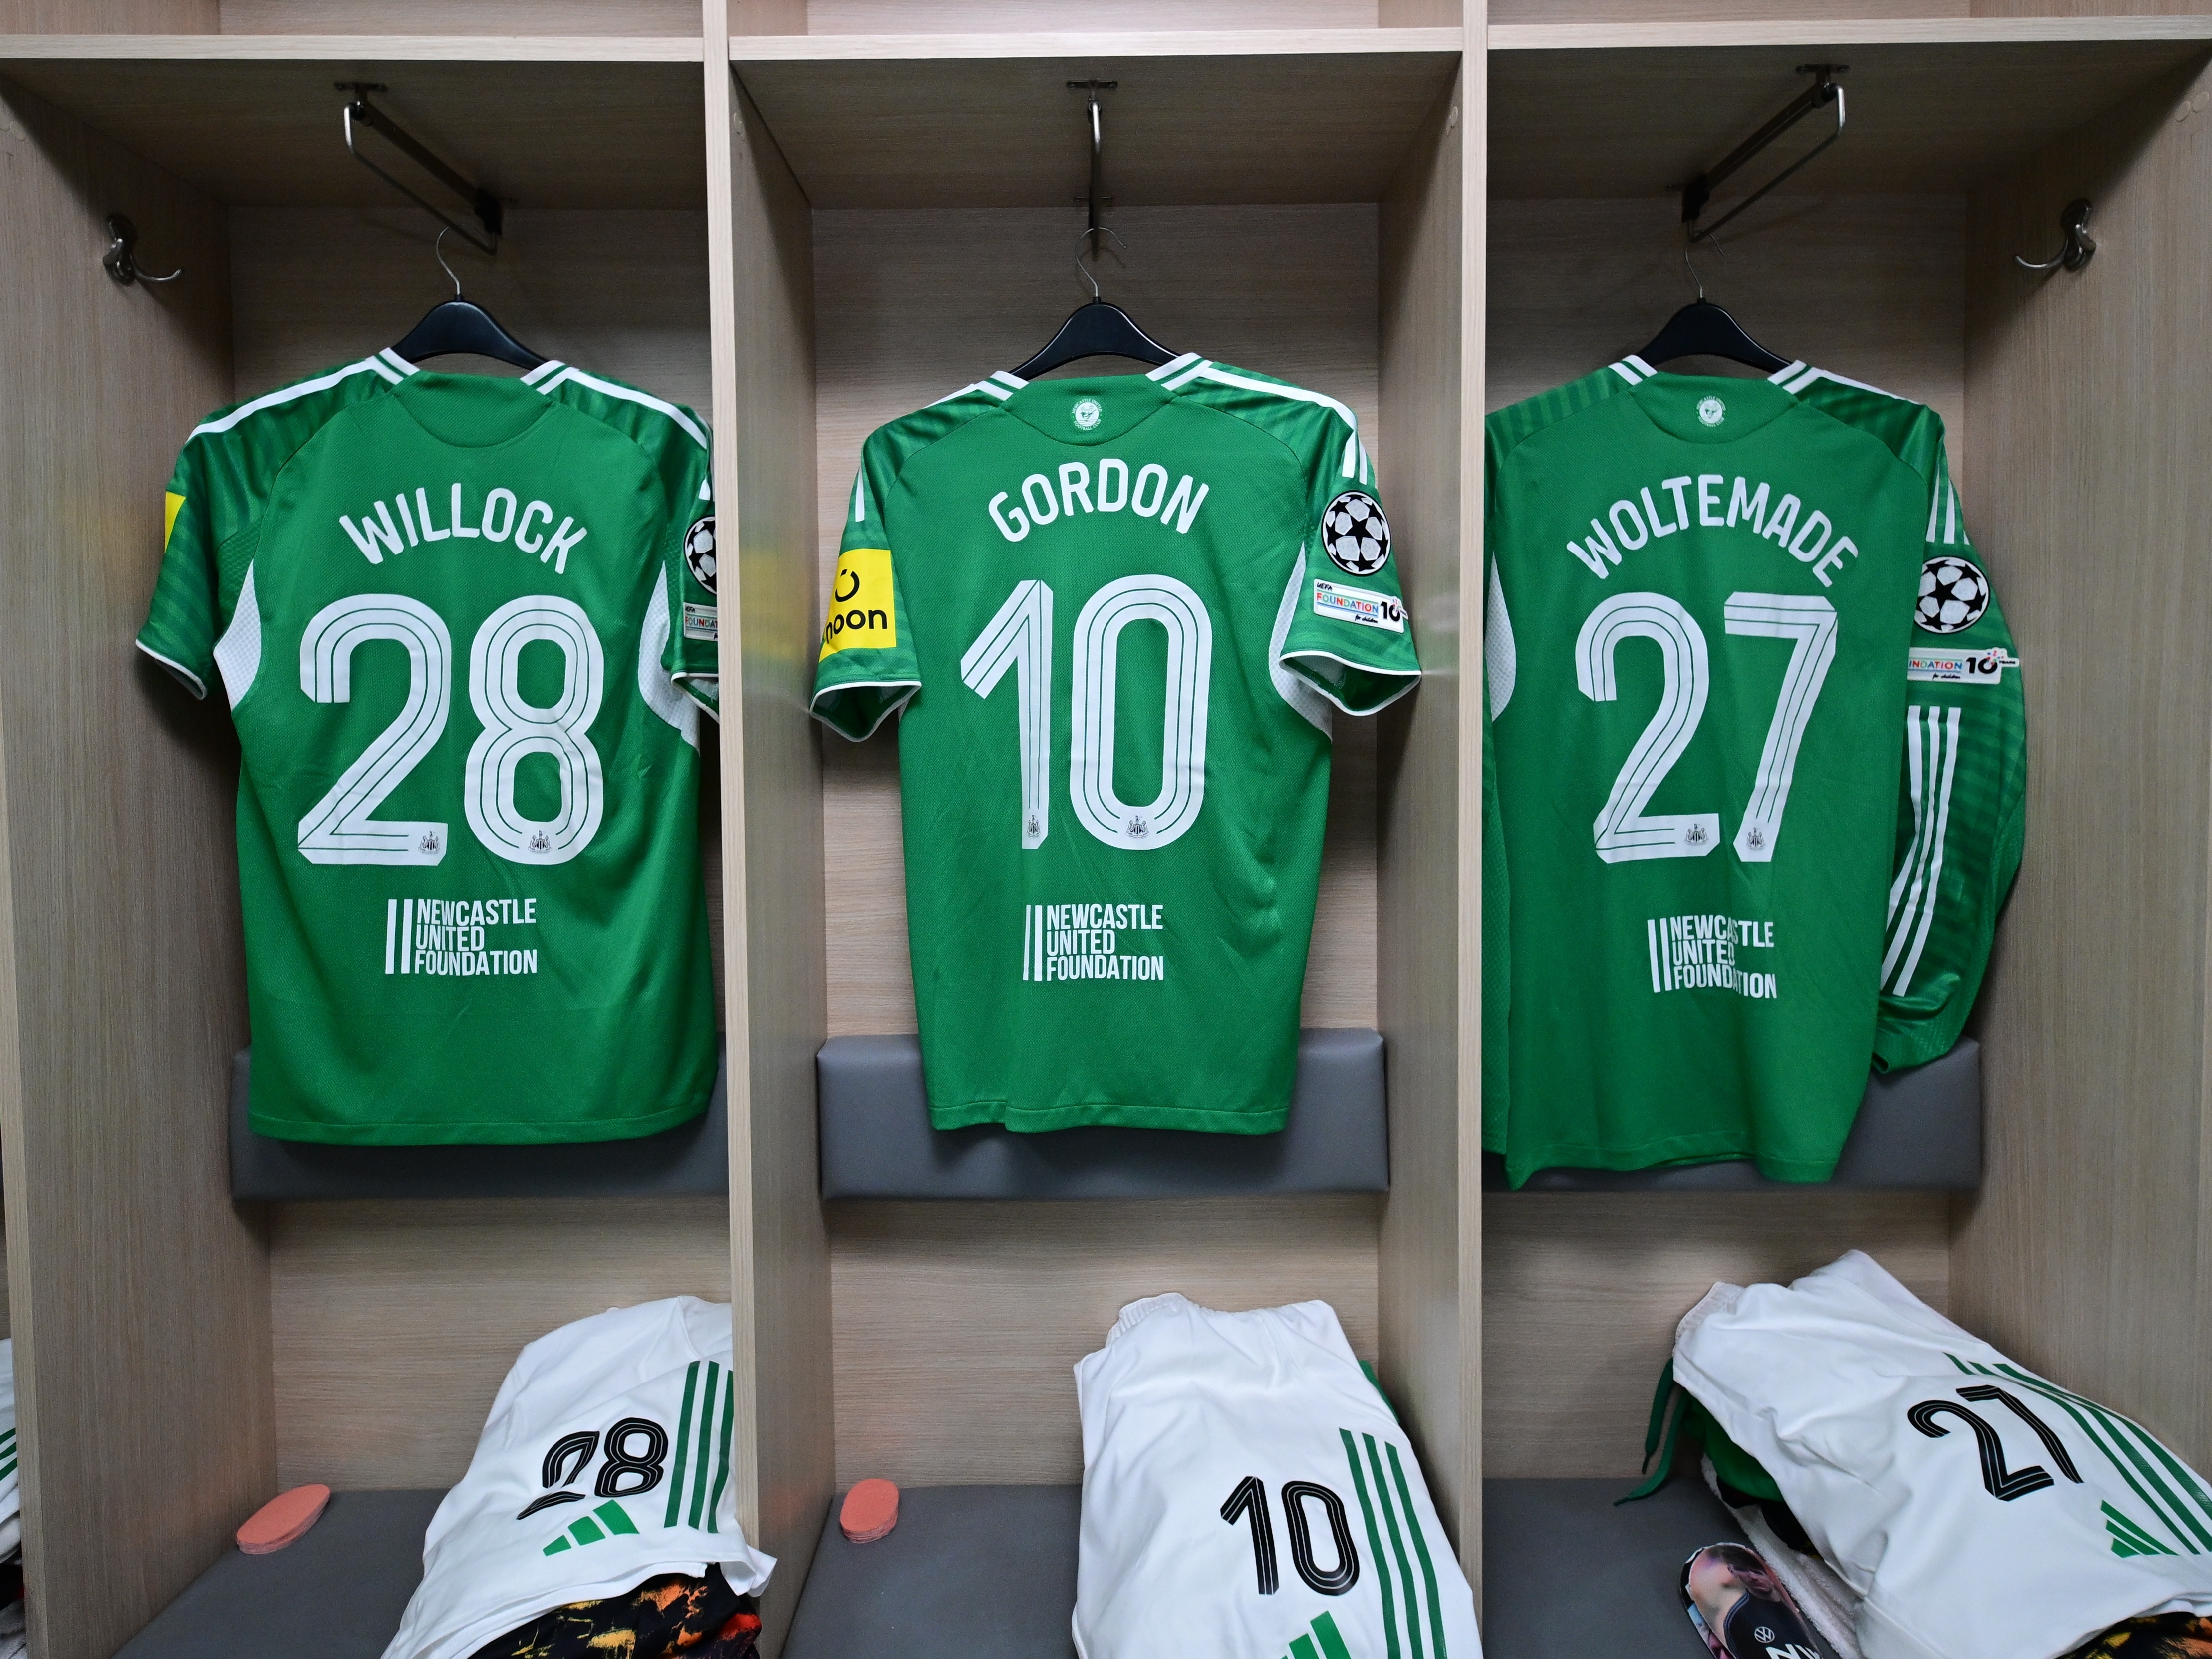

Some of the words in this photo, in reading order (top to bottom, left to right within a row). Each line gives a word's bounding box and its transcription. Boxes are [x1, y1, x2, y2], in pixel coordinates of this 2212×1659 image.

[988, 458, 1209, 542] GORDON
[339, 483, 587, 574] WILLOCK
[1566, 474, 1858, 587] WOLTEMADE
[1317, 582, 1333, 591] UEFA
[1317, 592, 1379, 613] FOUNDATION
[825, 610, 888, 644] noon
[1965, 657, 1998, 674] 10
[960, 574, 1213, 850] 10
[1575, 591, 1838, 864] 27
[298, 593, 604, 866] 28
[417, 898, 537, 926] NEWCASTLE
[1047, 904, 1163, 930] NEWCASTLE
[415, 924, 485, 952] UNITED
[1047, 929, 1115, 956] UNITED
[1670, 914, 1774, 948] NEWCASTLE
[415, 949, 537, 976] FOUNDATION
[1047, 955, 1163, 981] FOUNDATION
[1672, 939, 1735, 966] UNITED
[1673, 963, 1777, 999] FOUNDATION
[1907, 1384, 2084, 1502] 27
[516, 1416, 669, 1520] 28
[1220, 1476, 1360, 1596] 10
